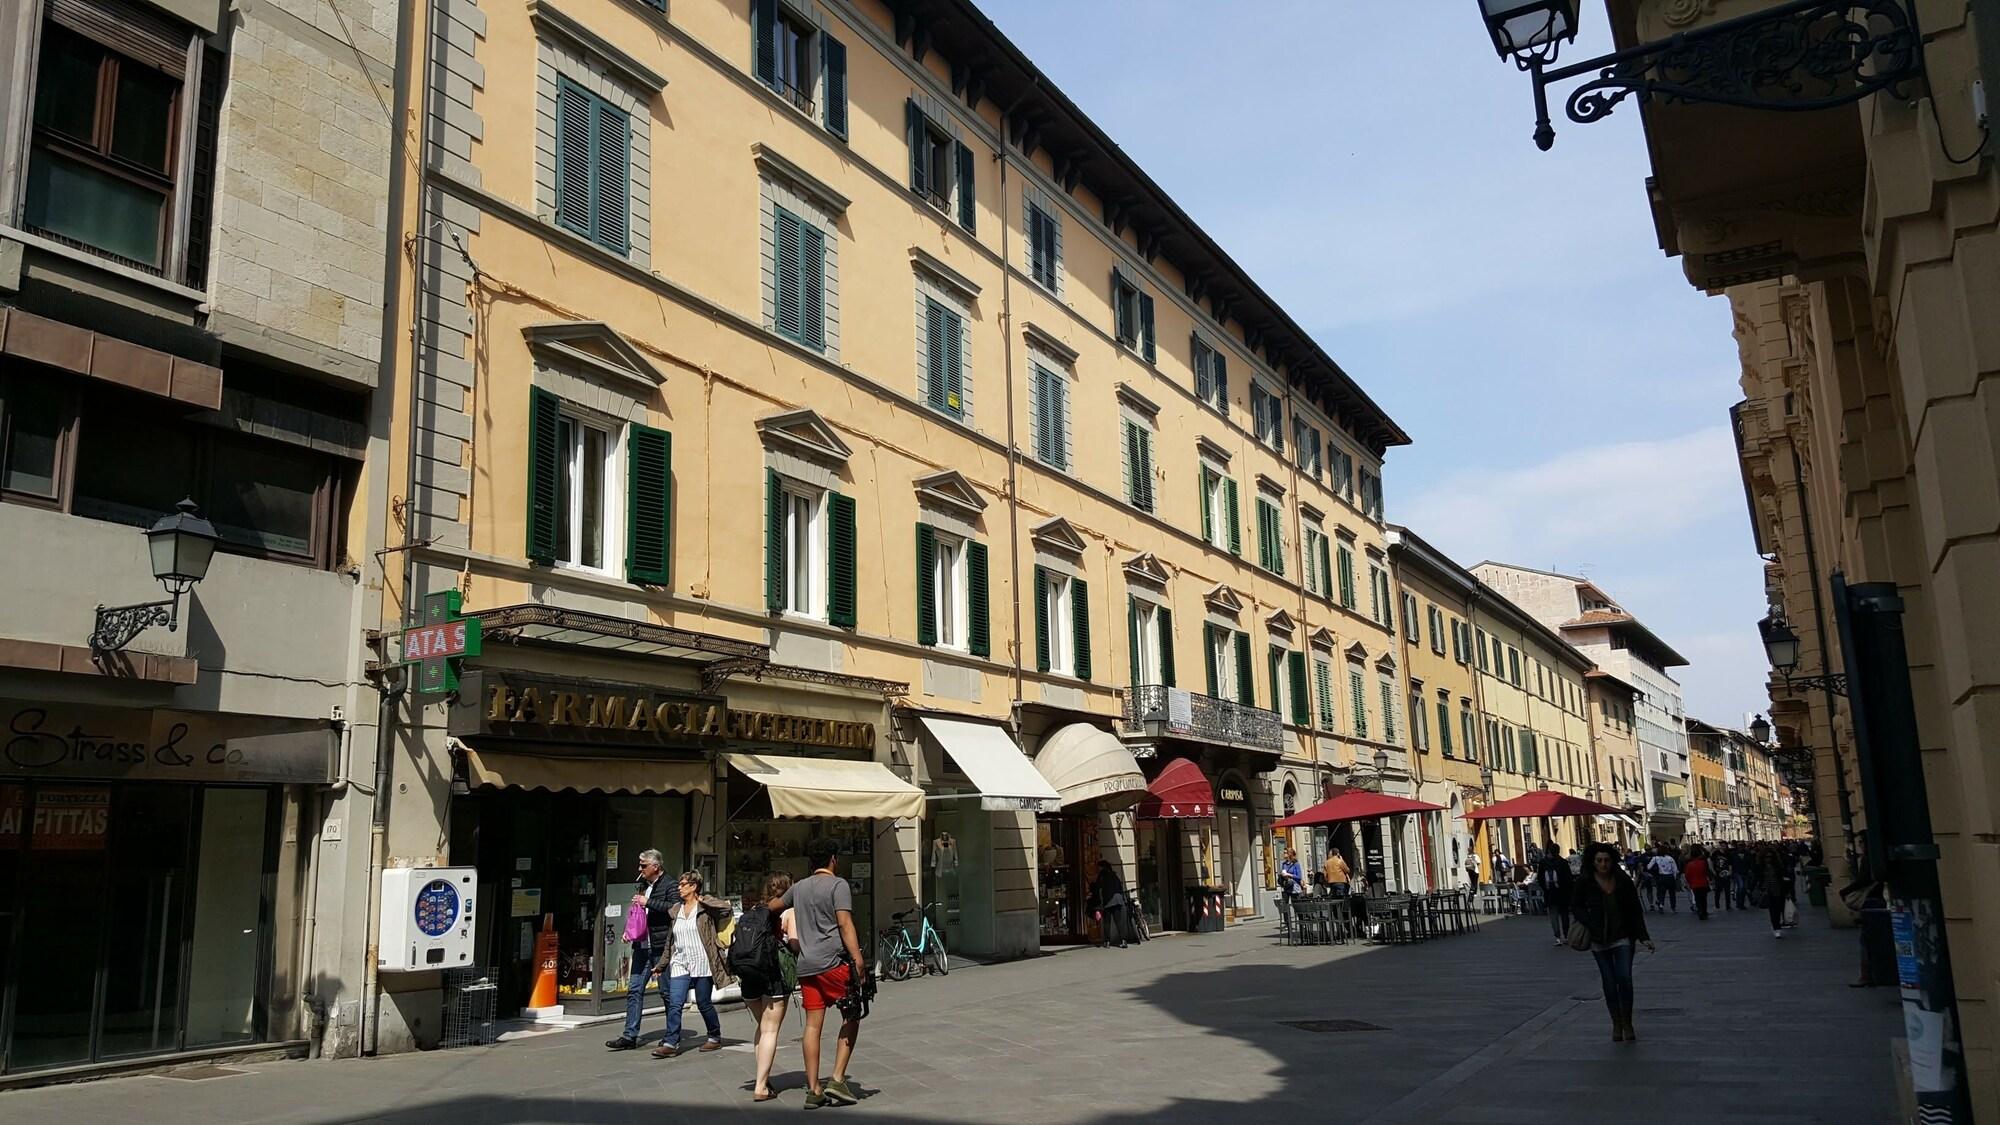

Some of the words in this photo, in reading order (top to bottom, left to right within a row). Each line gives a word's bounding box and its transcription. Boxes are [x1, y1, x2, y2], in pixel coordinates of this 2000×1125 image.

[5, 708, 146, 768] Strass
[154, 723, 194, 767] &
[487, 684, 727, 736] FARMACIA
